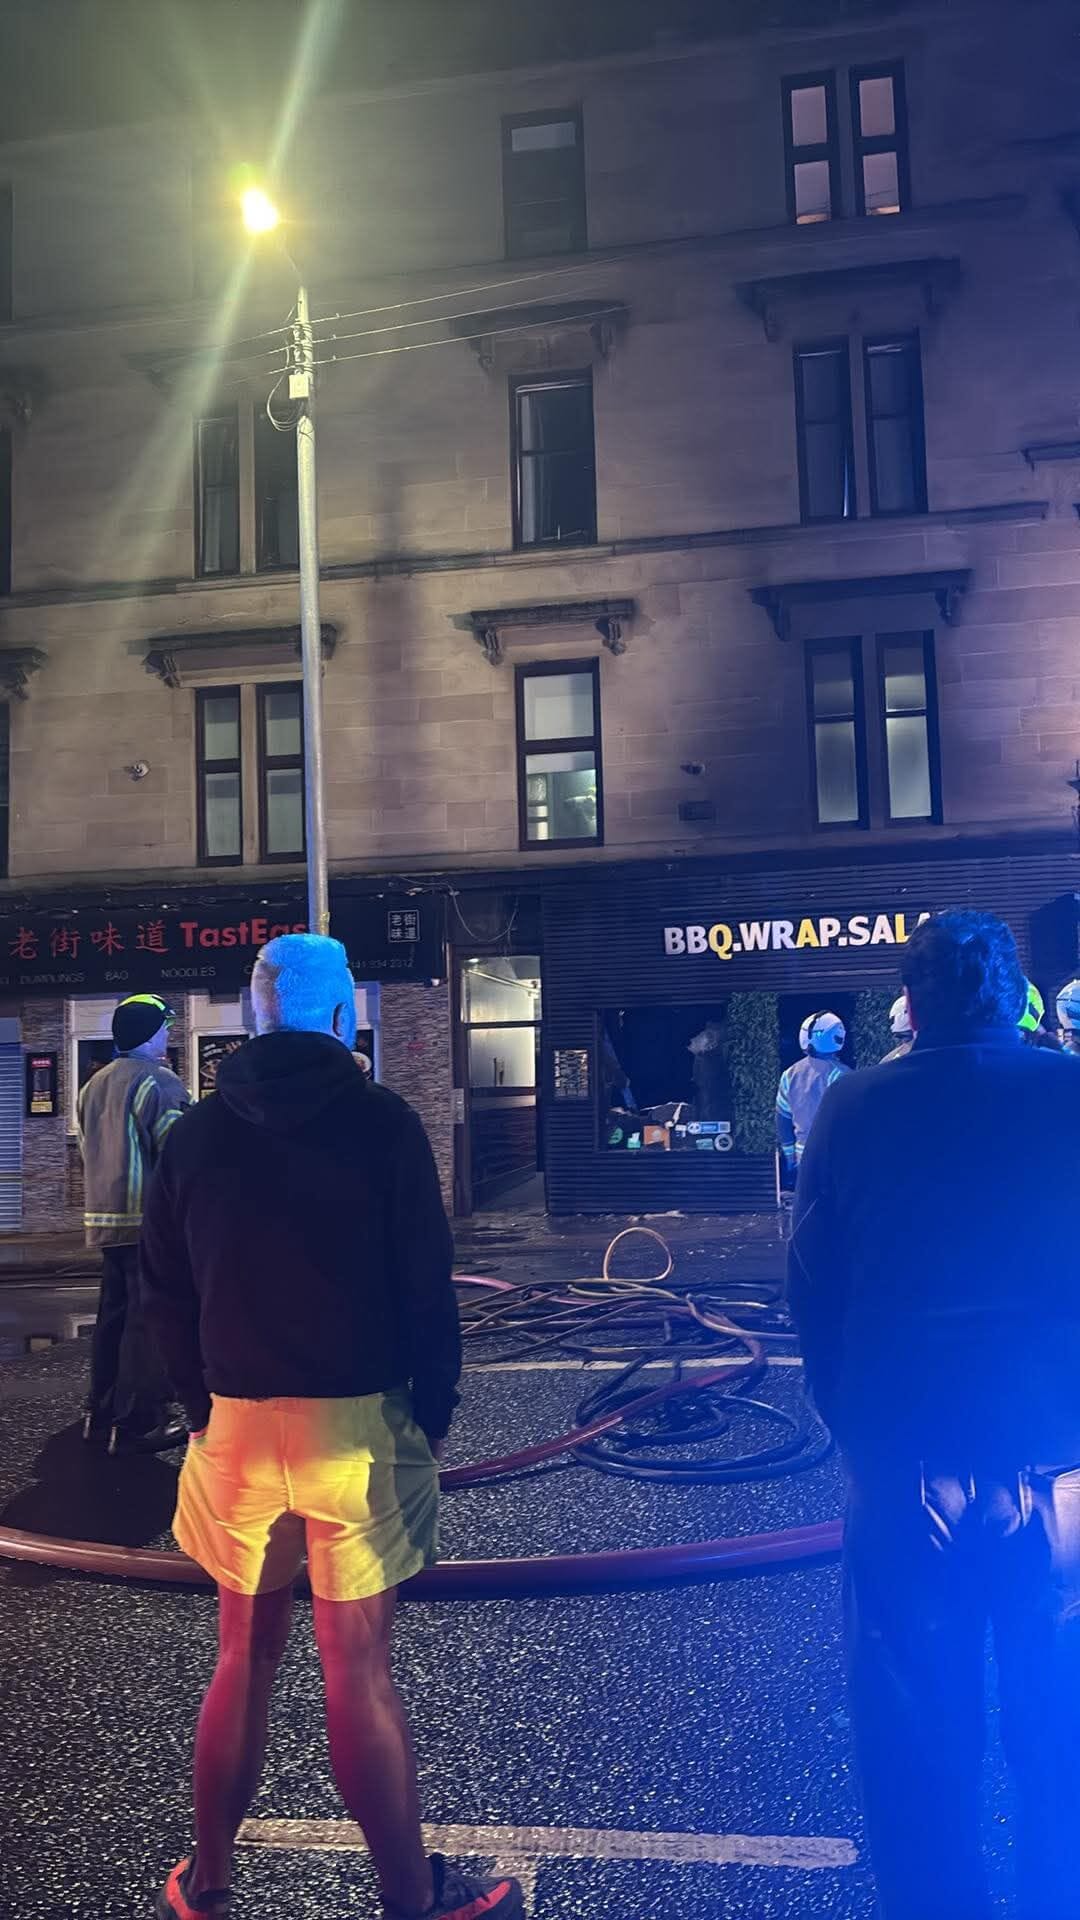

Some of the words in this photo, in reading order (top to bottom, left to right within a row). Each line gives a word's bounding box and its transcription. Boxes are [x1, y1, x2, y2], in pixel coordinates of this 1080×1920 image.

[8, 919, 169, 960] 老街味道
[180, 918, 307, 947] TastEas
[664, 912, 931, 959] BBQ.WRAP.SAL
[105, 970, 129, 982] BAO
[161, 966, 217, 978] NOODLES
